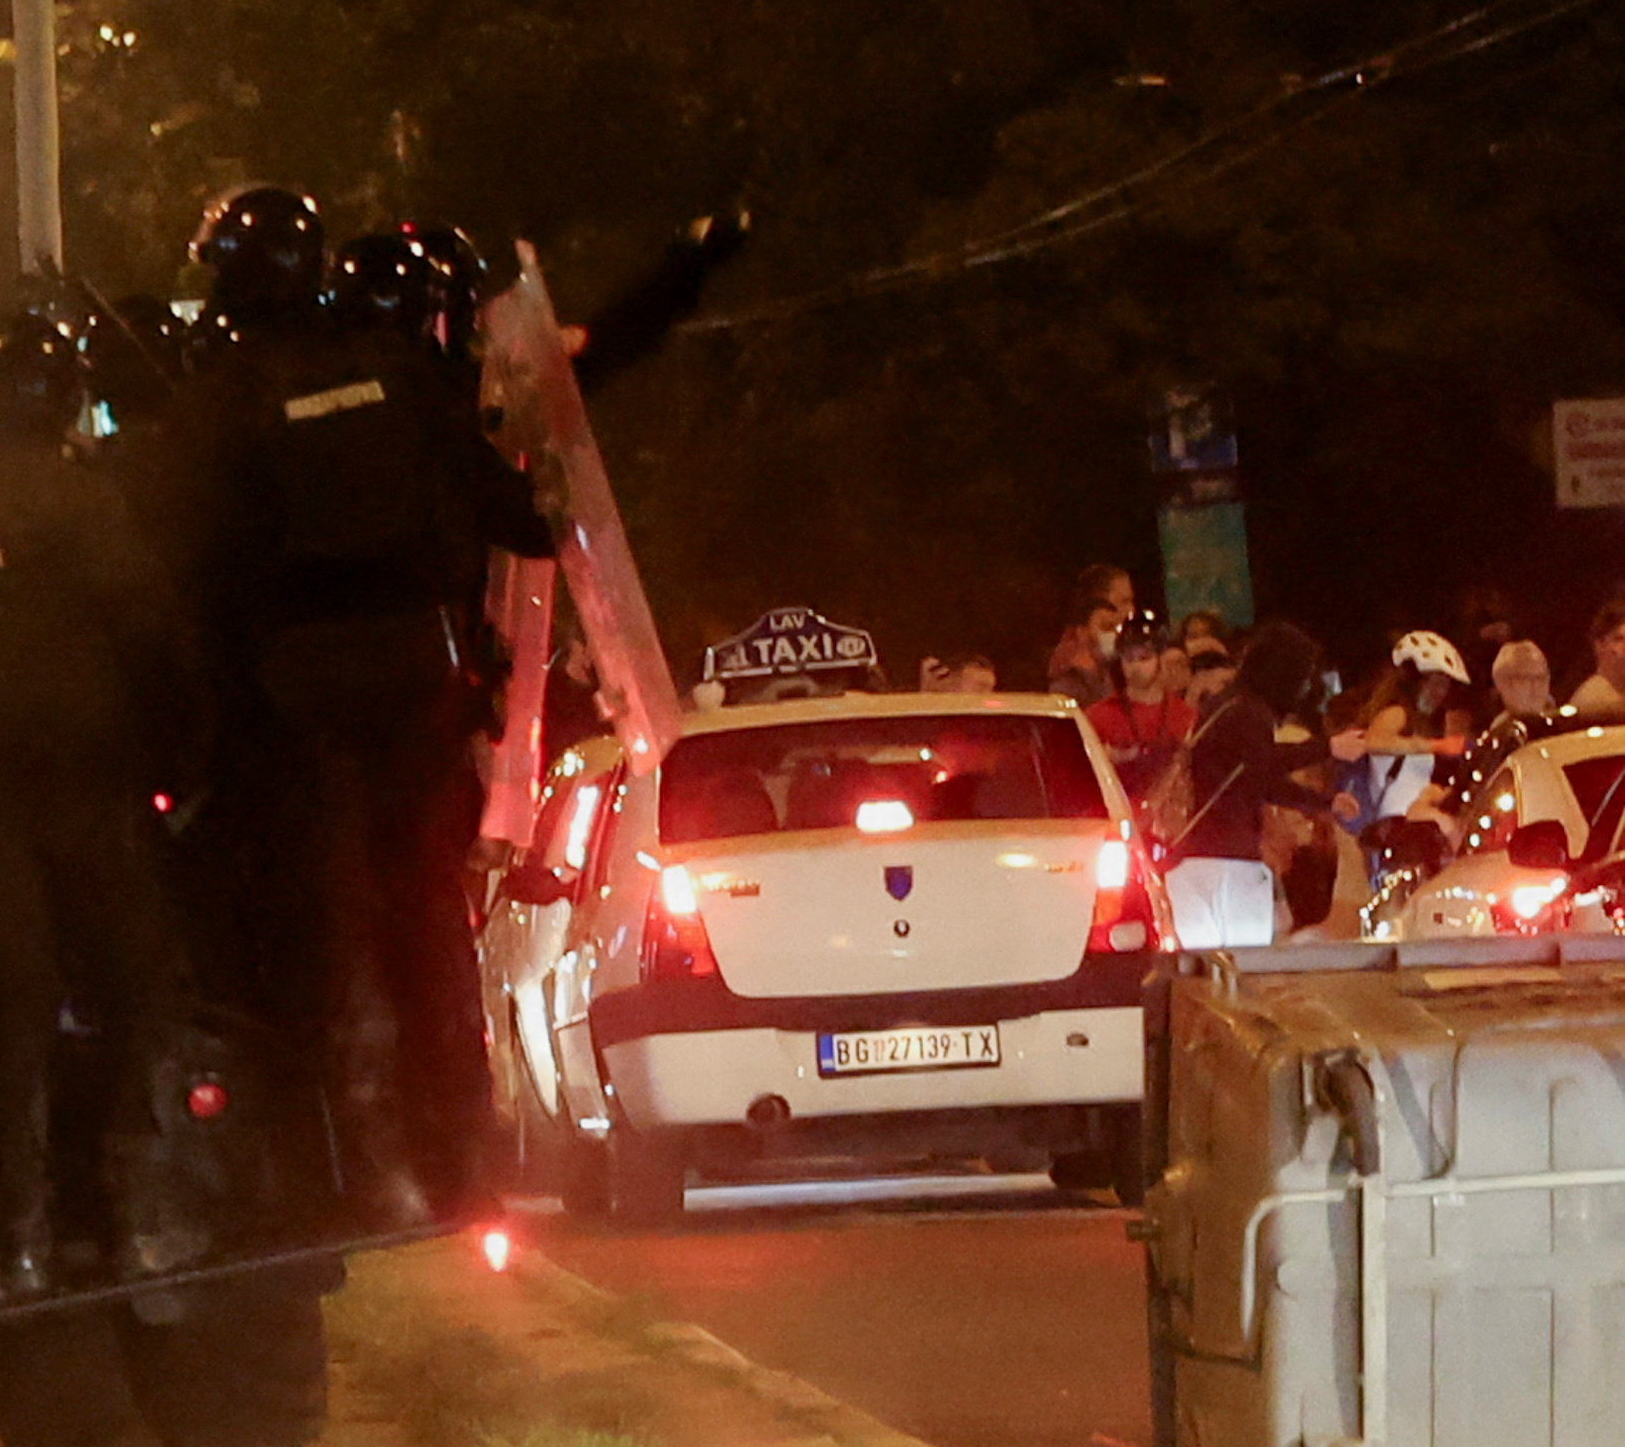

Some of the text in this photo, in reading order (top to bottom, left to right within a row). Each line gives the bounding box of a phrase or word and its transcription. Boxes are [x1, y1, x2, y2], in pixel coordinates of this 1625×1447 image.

[769, 614, 806, 632] LAV
[752, 632, 833, 664] TAXI
[837, 1037, 869, 1065] BG
